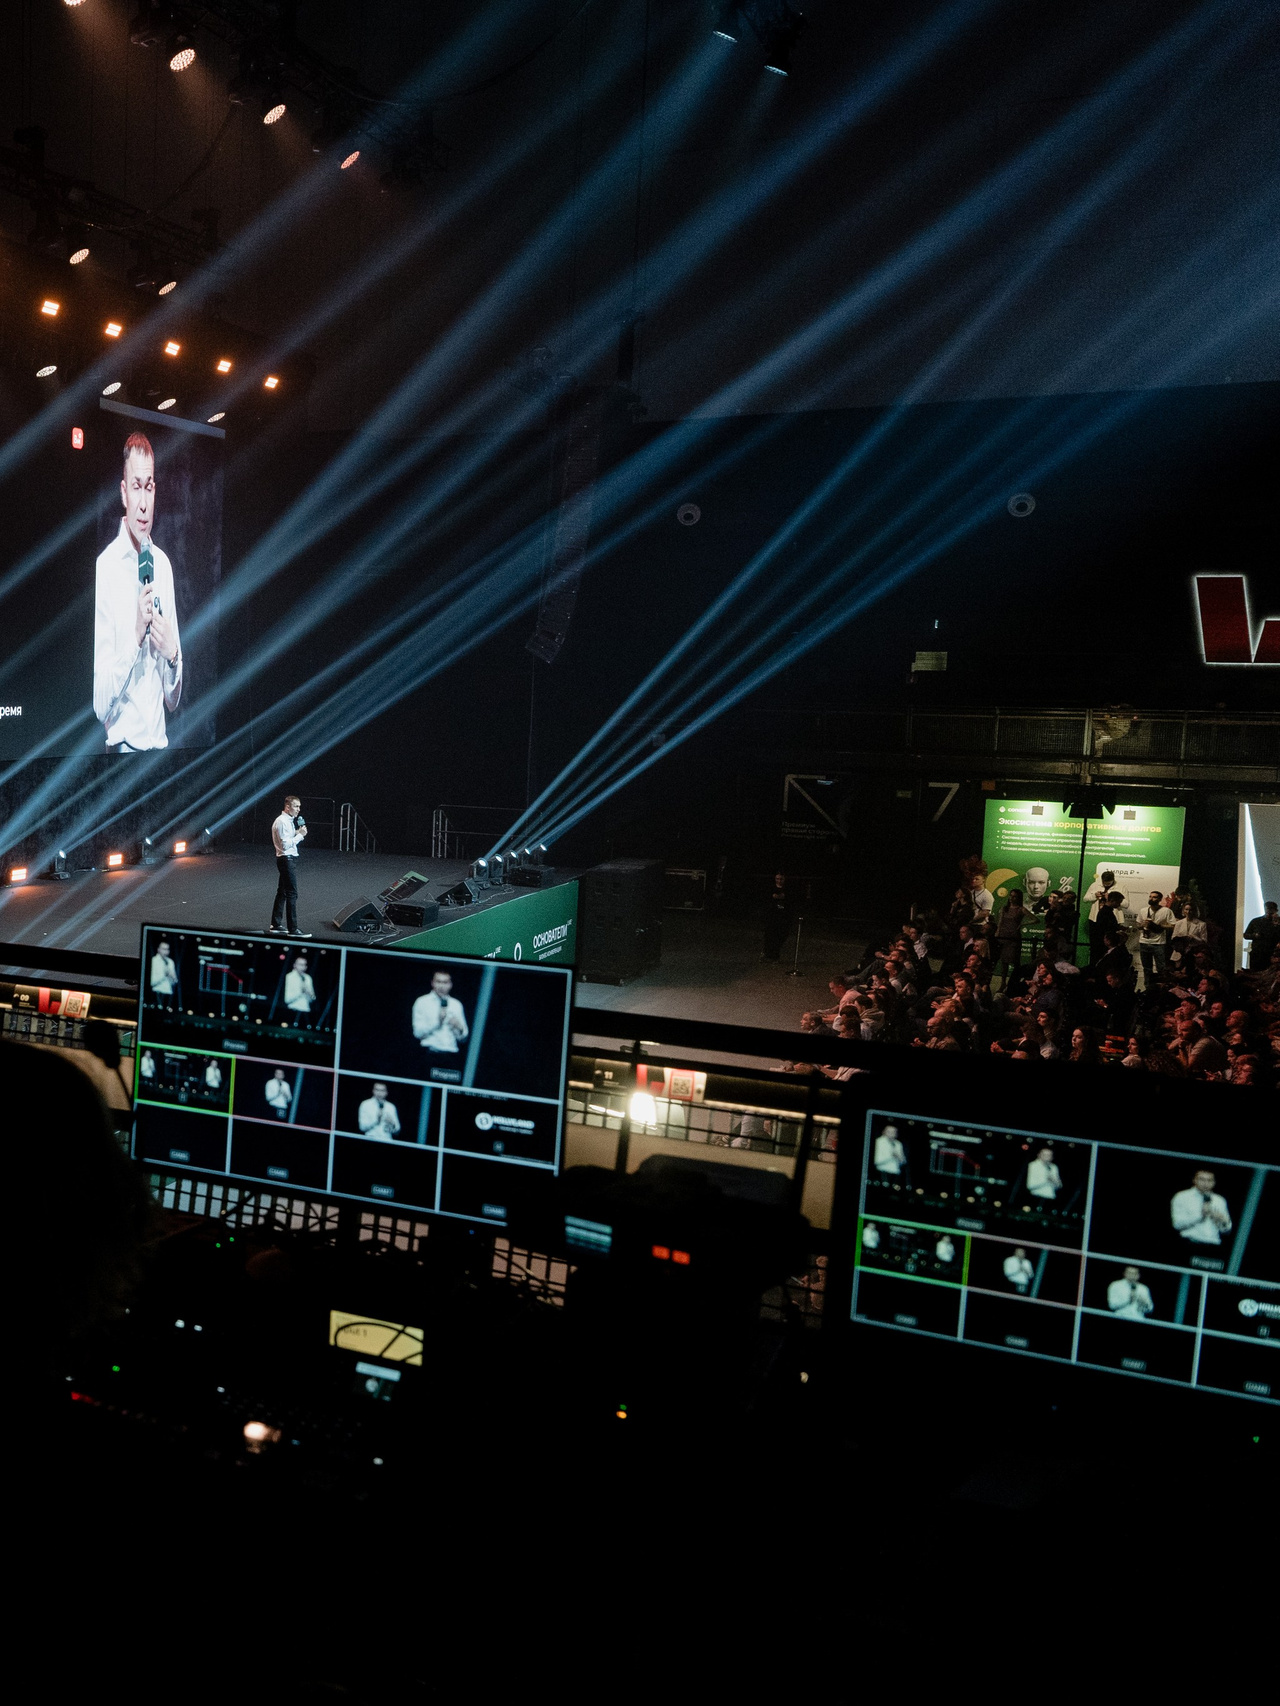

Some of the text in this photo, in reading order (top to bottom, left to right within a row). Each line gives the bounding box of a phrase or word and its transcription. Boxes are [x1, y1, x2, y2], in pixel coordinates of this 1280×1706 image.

[927, 781, 960, 823] 7
[999, 818, 1162, 834] Экосистема корпоративных долгов
[533, 924, 568, 949] ОСНОВАТЕЛИ
